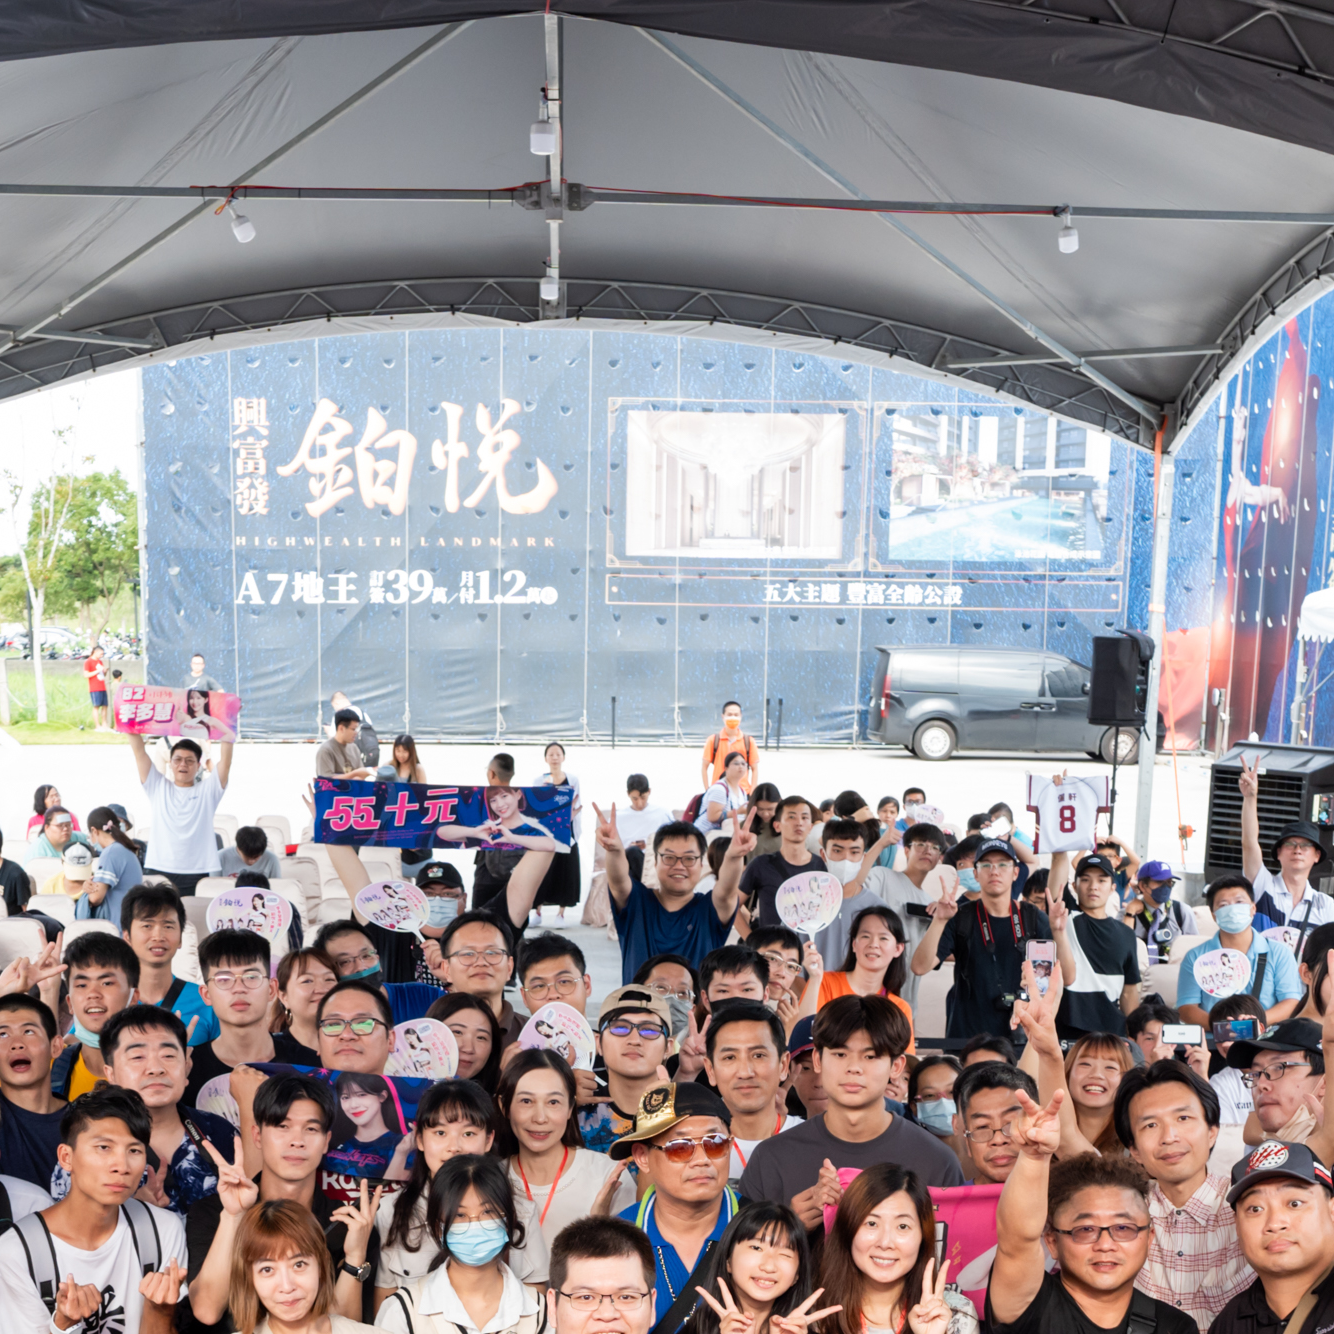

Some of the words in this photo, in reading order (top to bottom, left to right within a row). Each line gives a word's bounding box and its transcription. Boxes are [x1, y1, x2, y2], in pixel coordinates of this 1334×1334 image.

[232, 397, 270, 515] 興富發
[236, 536, 402, 547] HIGHWEALTH
[420, 536, 556, 547] LANDMARK
[235, 571, 359, 605] A7地王
[763, 583, 840, 604] 五大主題
[846, 585, 963, 606] 豐富全齡公設
[1060, 805, 1075, 832] 8
[185, 1119, 200, 1141] Canon
